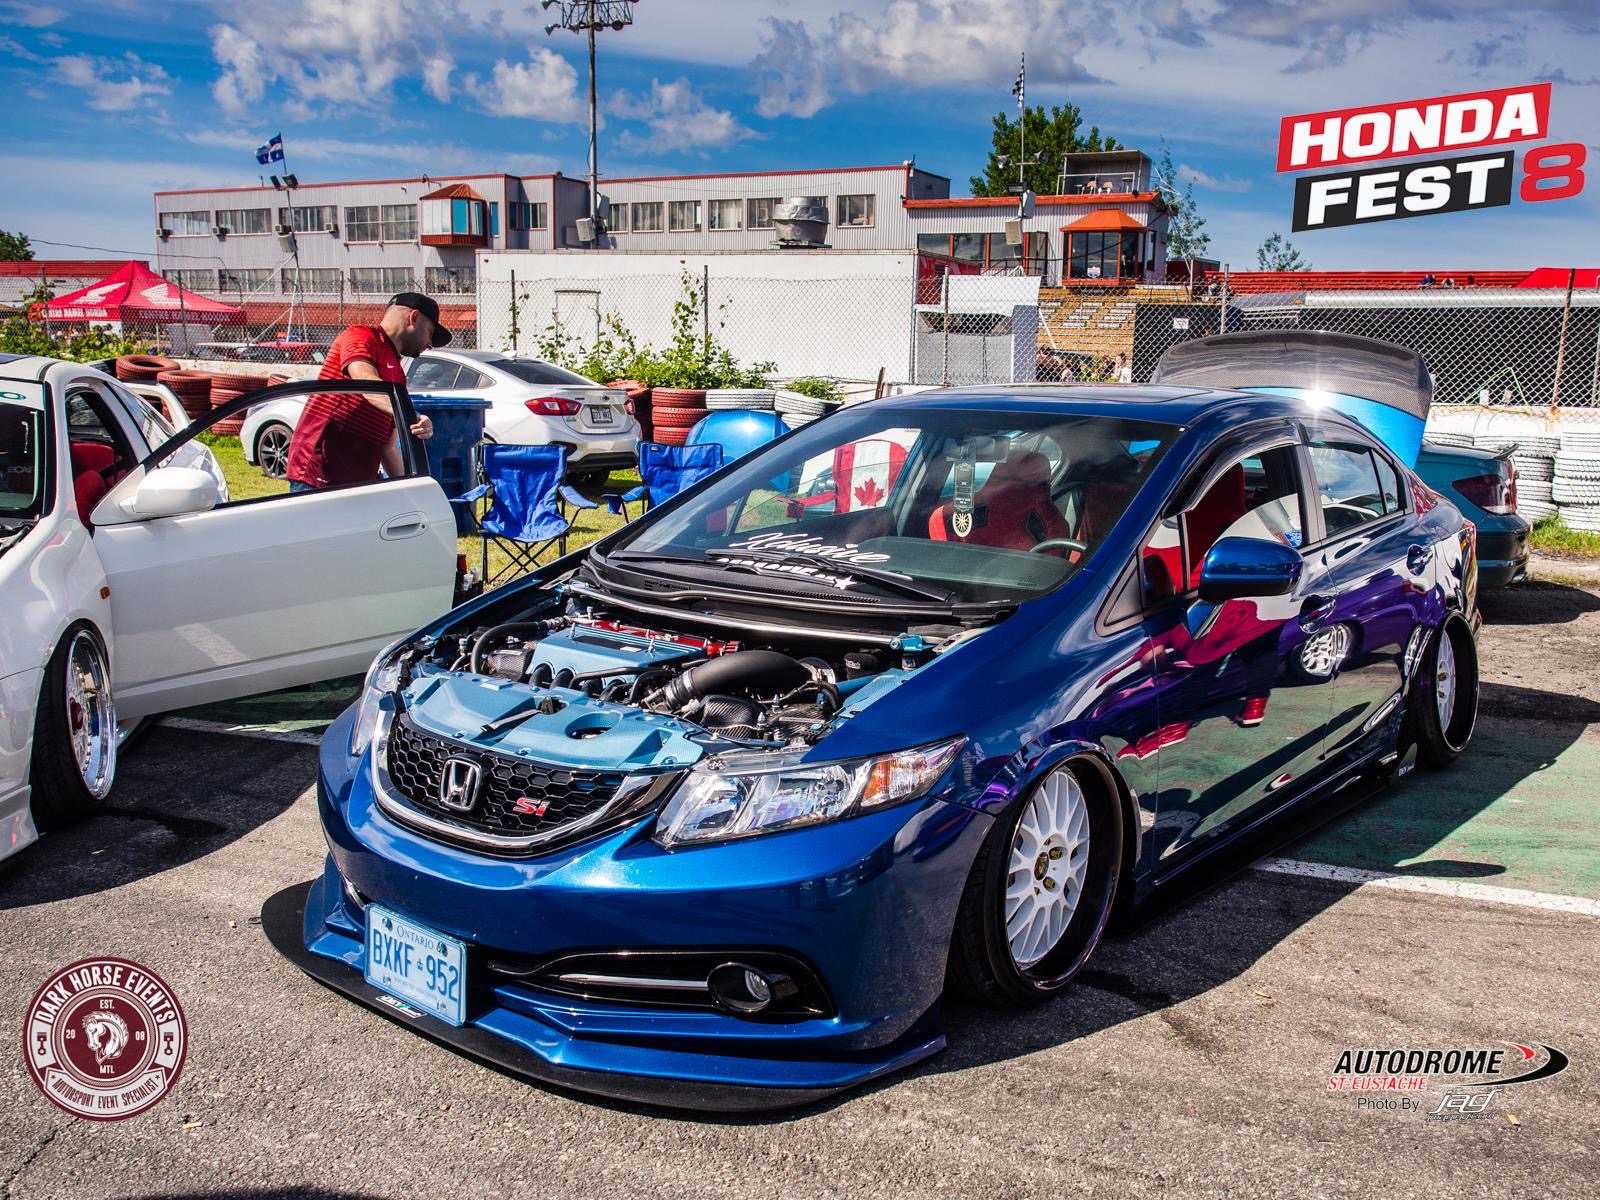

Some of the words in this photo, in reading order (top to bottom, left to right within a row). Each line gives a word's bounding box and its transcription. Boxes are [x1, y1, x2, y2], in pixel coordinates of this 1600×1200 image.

[513, 797, 550, 817] Si
[396, 925, 434, 950] ONTARIO
[373, 928, 415, 978] BXKF
[426, 954, 458, 1002] 952
